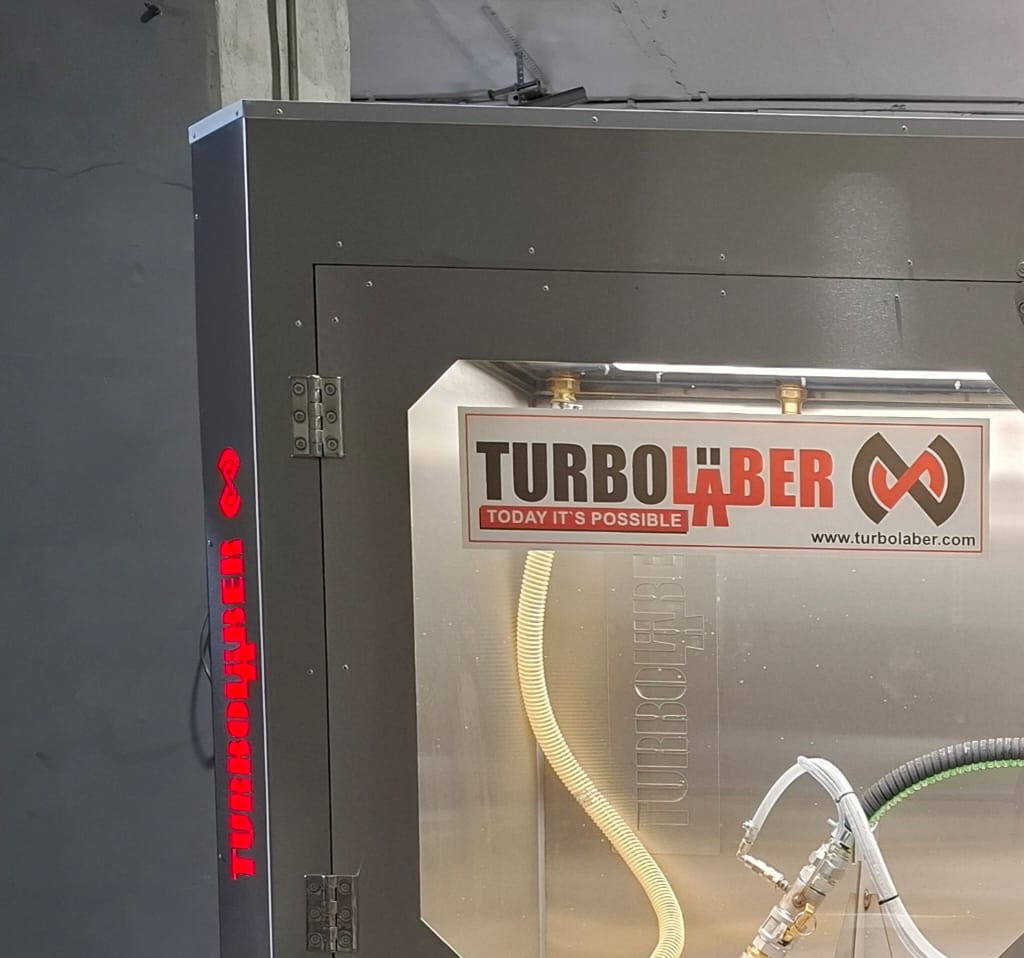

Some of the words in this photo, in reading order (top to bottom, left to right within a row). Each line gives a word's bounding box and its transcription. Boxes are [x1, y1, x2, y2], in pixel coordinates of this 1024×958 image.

[487, 509, 547, 524] TODAY
[591, 512, 682, 527] POSSIBLE
[811, 531, 976, 546] www.turbolaber.com
